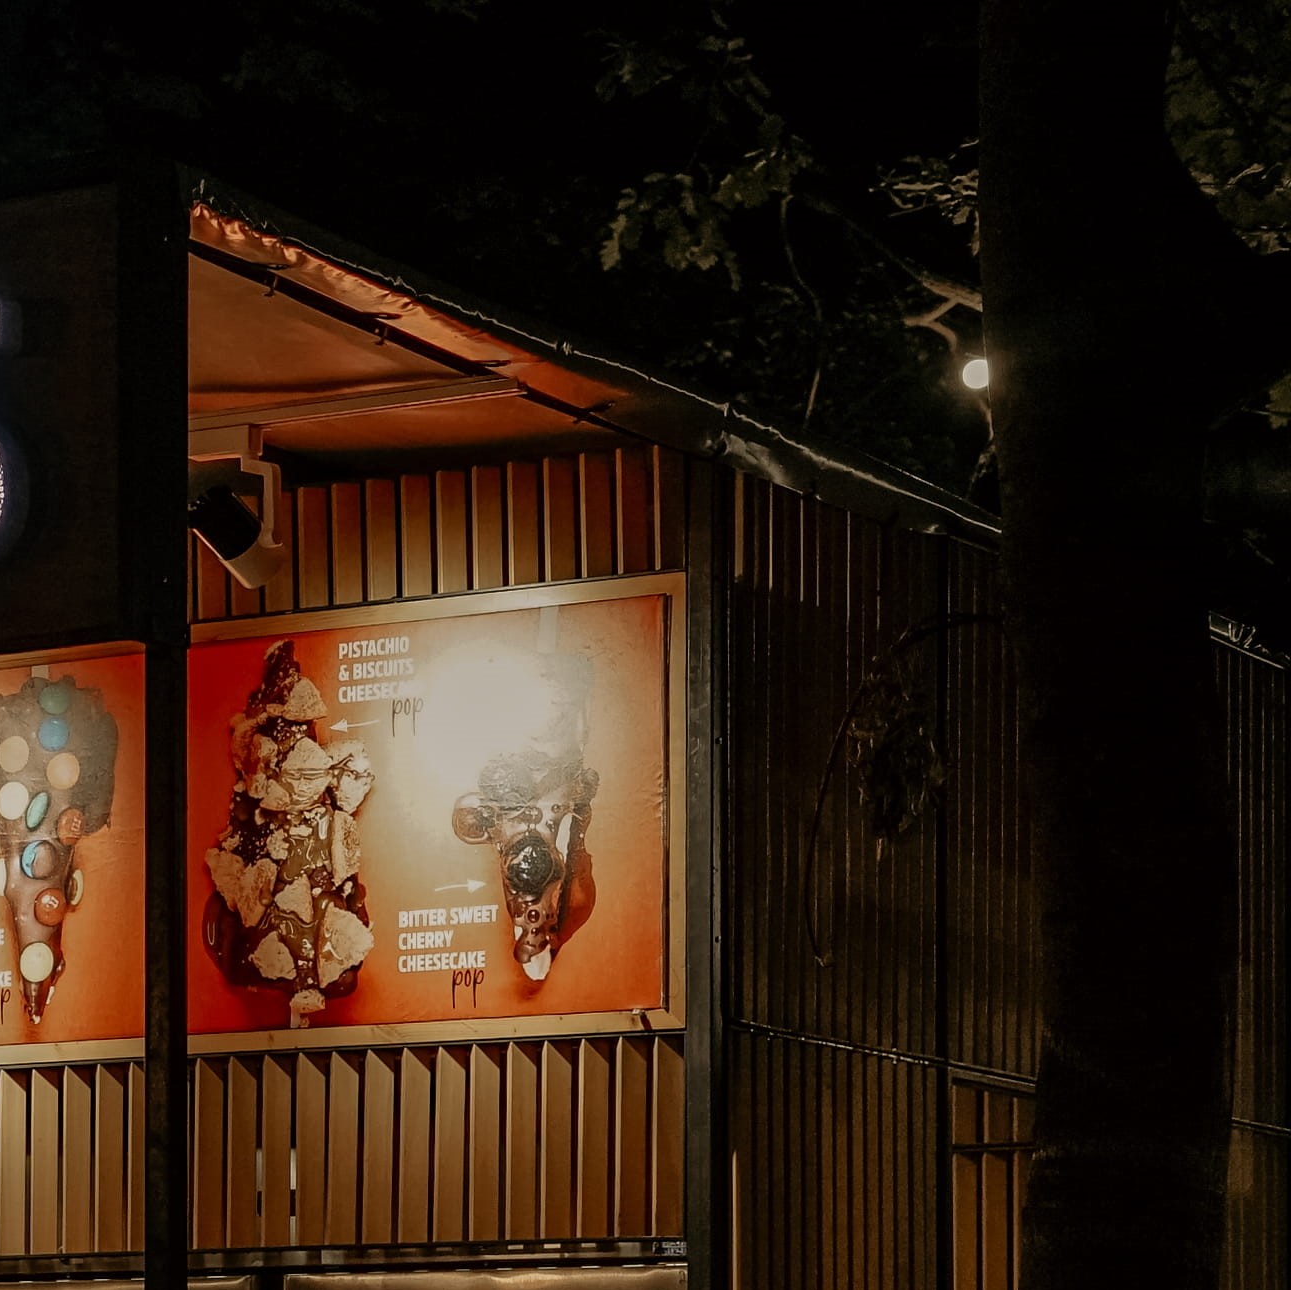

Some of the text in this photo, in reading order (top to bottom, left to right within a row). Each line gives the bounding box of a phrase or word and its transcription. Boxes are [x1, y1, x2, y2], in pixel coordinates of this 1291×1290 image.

[338, 636, 410, 660] PISTACHIO
[338, 658, 414, 682] & BISCUITS
[398, 905, 499, 928] BITTER SWEET
[398, 930, 453, 951] CHERRY
[398, 950, 486, 973] CHEESECAKE
[451, 969, 485, 1009] pop
